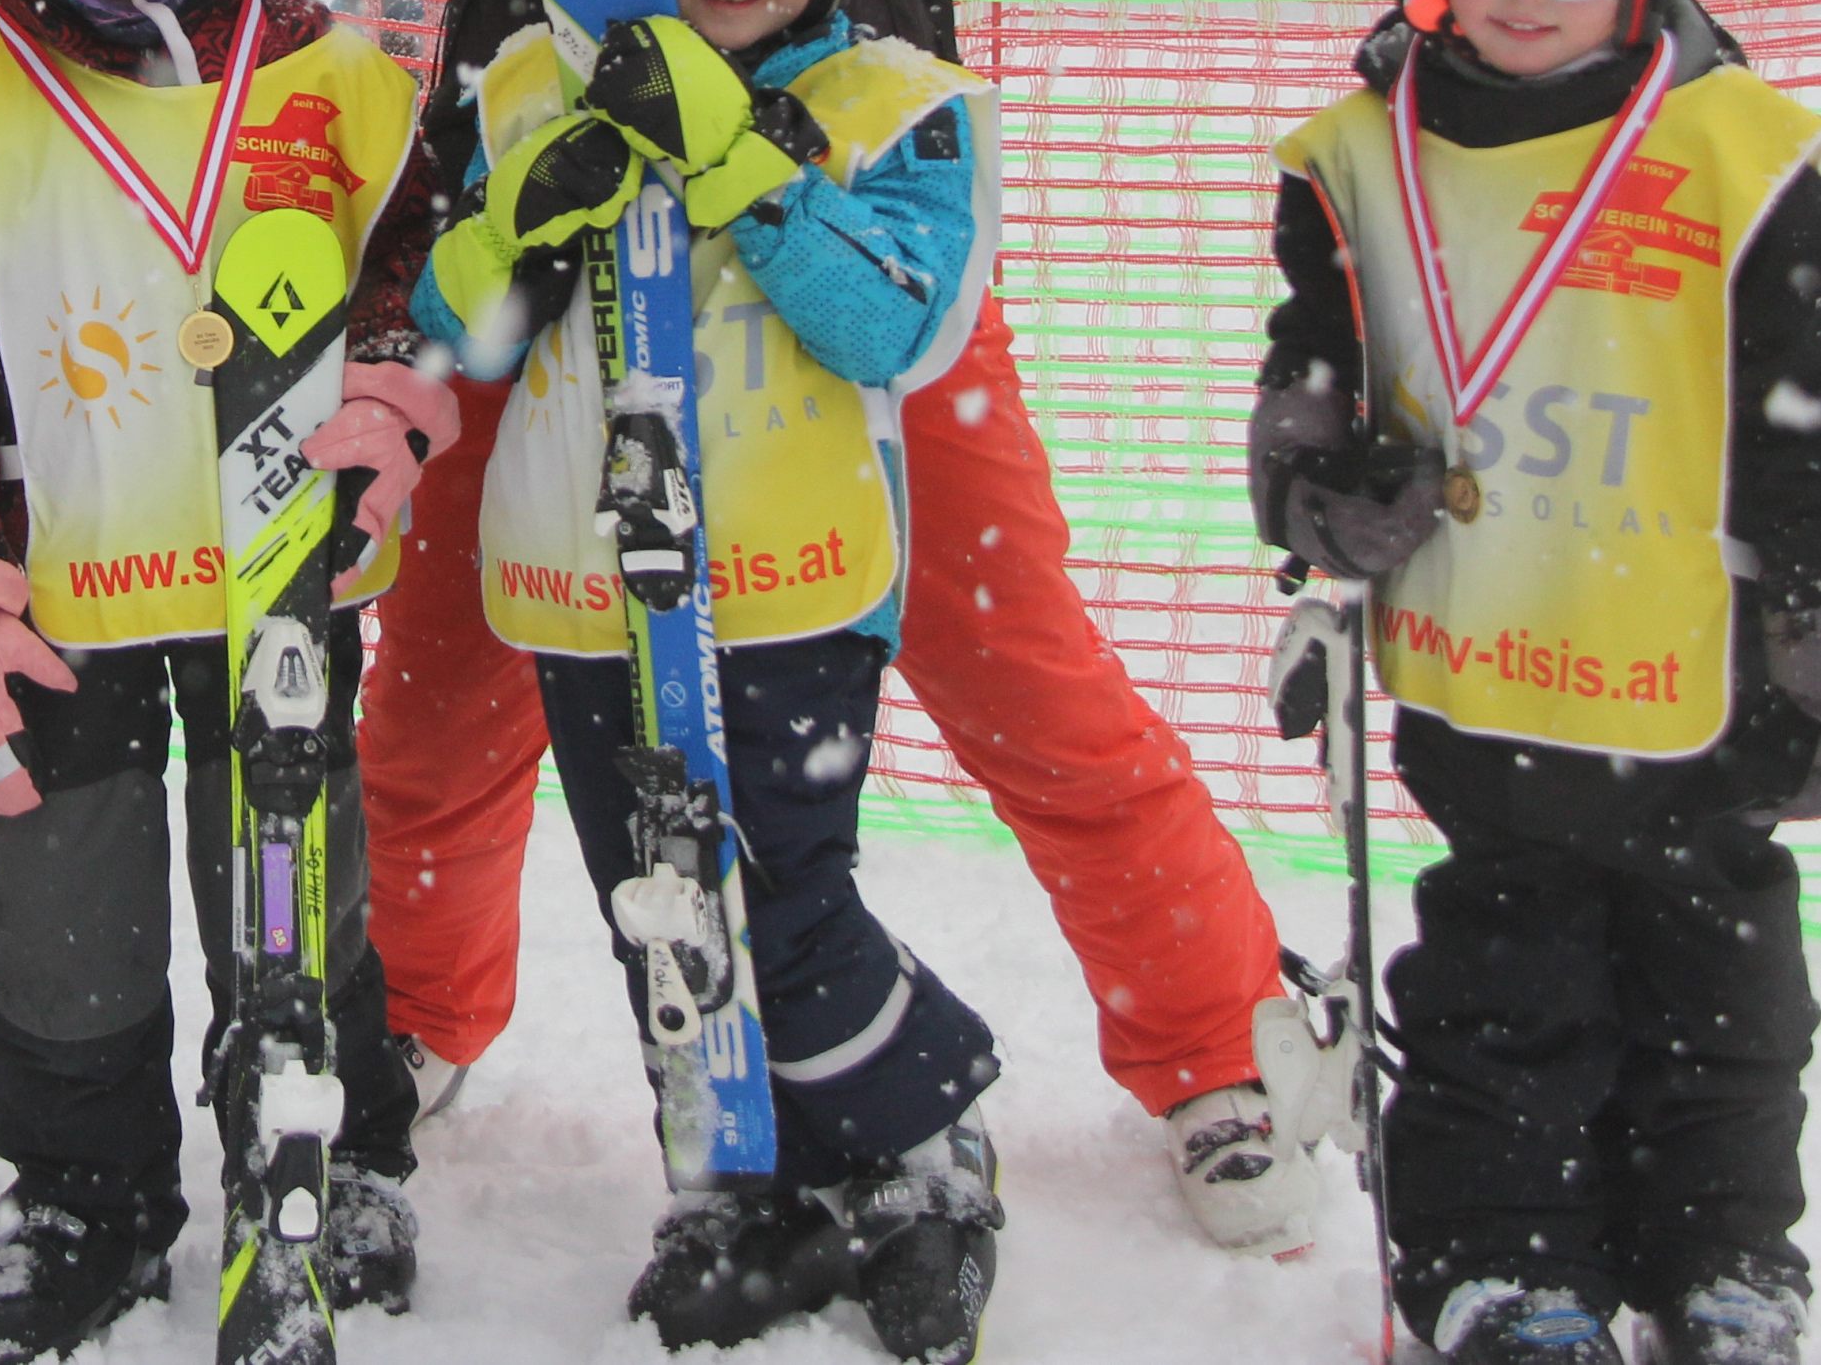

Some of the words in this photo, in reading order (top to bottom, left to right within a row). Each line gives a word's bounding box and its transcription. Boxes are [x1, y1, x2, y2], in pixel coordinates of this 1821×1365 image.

[631, 289, 651, 371] OMIC
[235, 405, 295, 472] XT
[723, 396, 822, 438] LAR
[241, 446, 316, 515] TEA
[692, 583, 729, 765] ATOMIC
